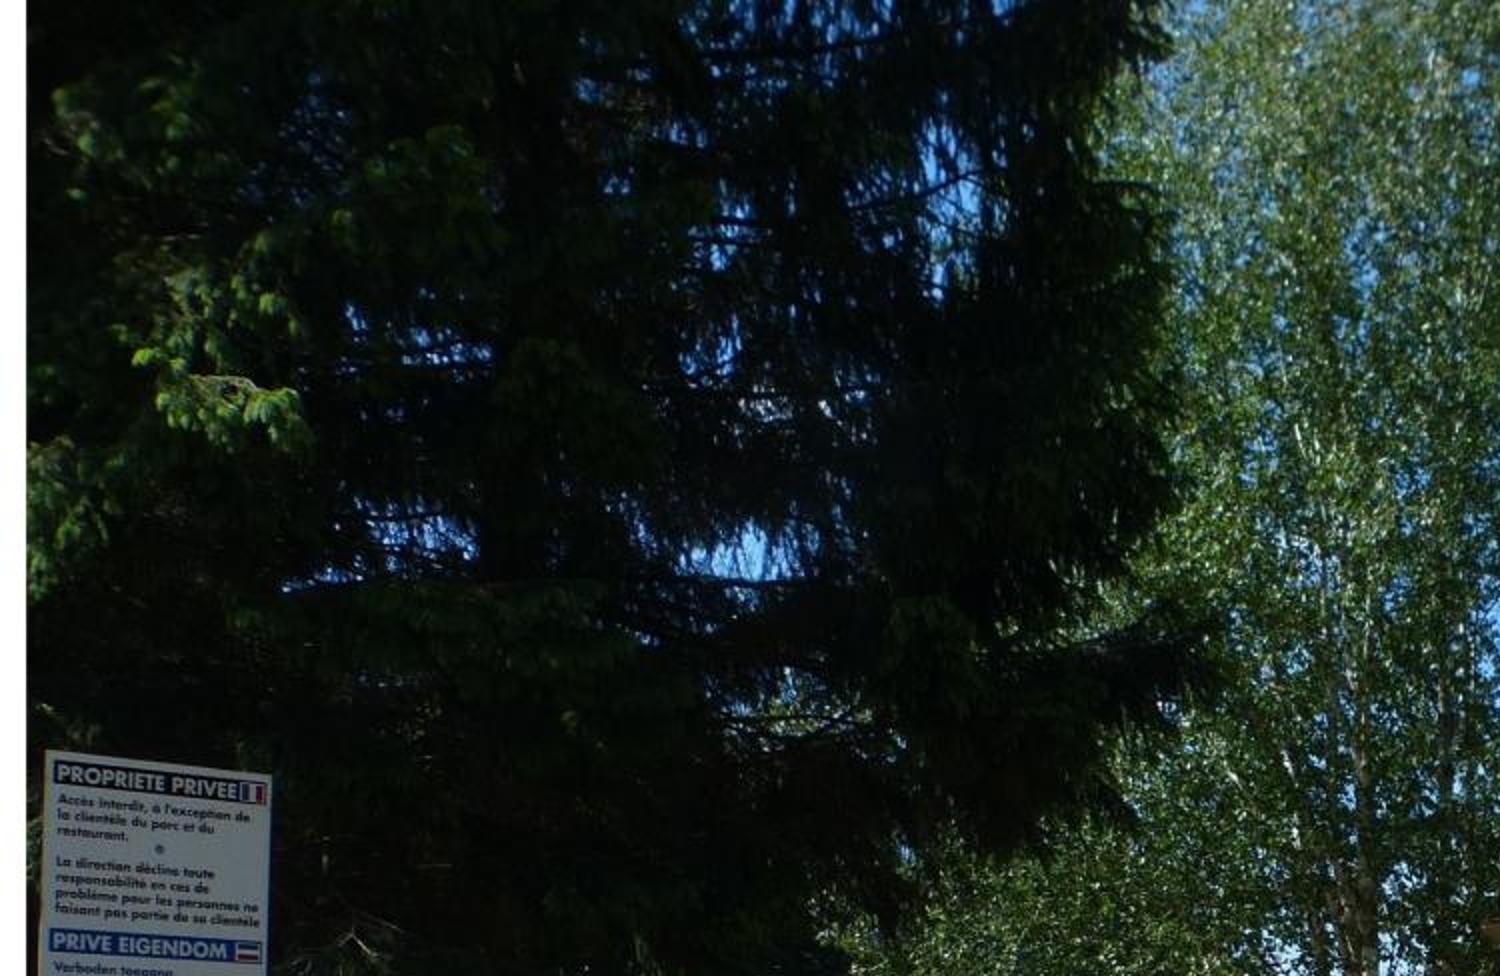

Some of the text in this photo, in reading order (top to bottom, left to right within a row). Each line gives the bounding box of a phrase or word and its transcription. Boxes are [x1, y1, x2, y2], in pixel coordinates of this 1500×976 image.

[57, 763, 237, 799] PROPRIETE PRIVEE
[57, 808, 71, 821] la
[131, 816, 147, 827] du
[152, 821, 178, 832] parc
[183, 821, 196, 832] et
[199, 822, 215, 834] du
[166, 804, 231, 822] l'exception
[235, 811, 251, 823] de
[57, 827, 128, 842] restaurant.
[56, 856, 71, 868] La
[76, 857, 131, 872] direction
[183, 868, 215, 879] toute
[151, 881, 166, 890] en
[170, 884, 190, 893] cas
[194, 882, 209, 894] de
[55, 903, 100, 916] faisant
[104, 909, 127, 920] pas
[131, 909, 169, 922] partie
[121, 892, 149, 905] pour
[155, 894, 172, 905] les
[176, 898, 240, 914] personnes
[243, 903, 258, 912] ne
[53, 932, 227, 959] PRIVE EIGENDOM
[53, 960, 116, 975] Verboden
